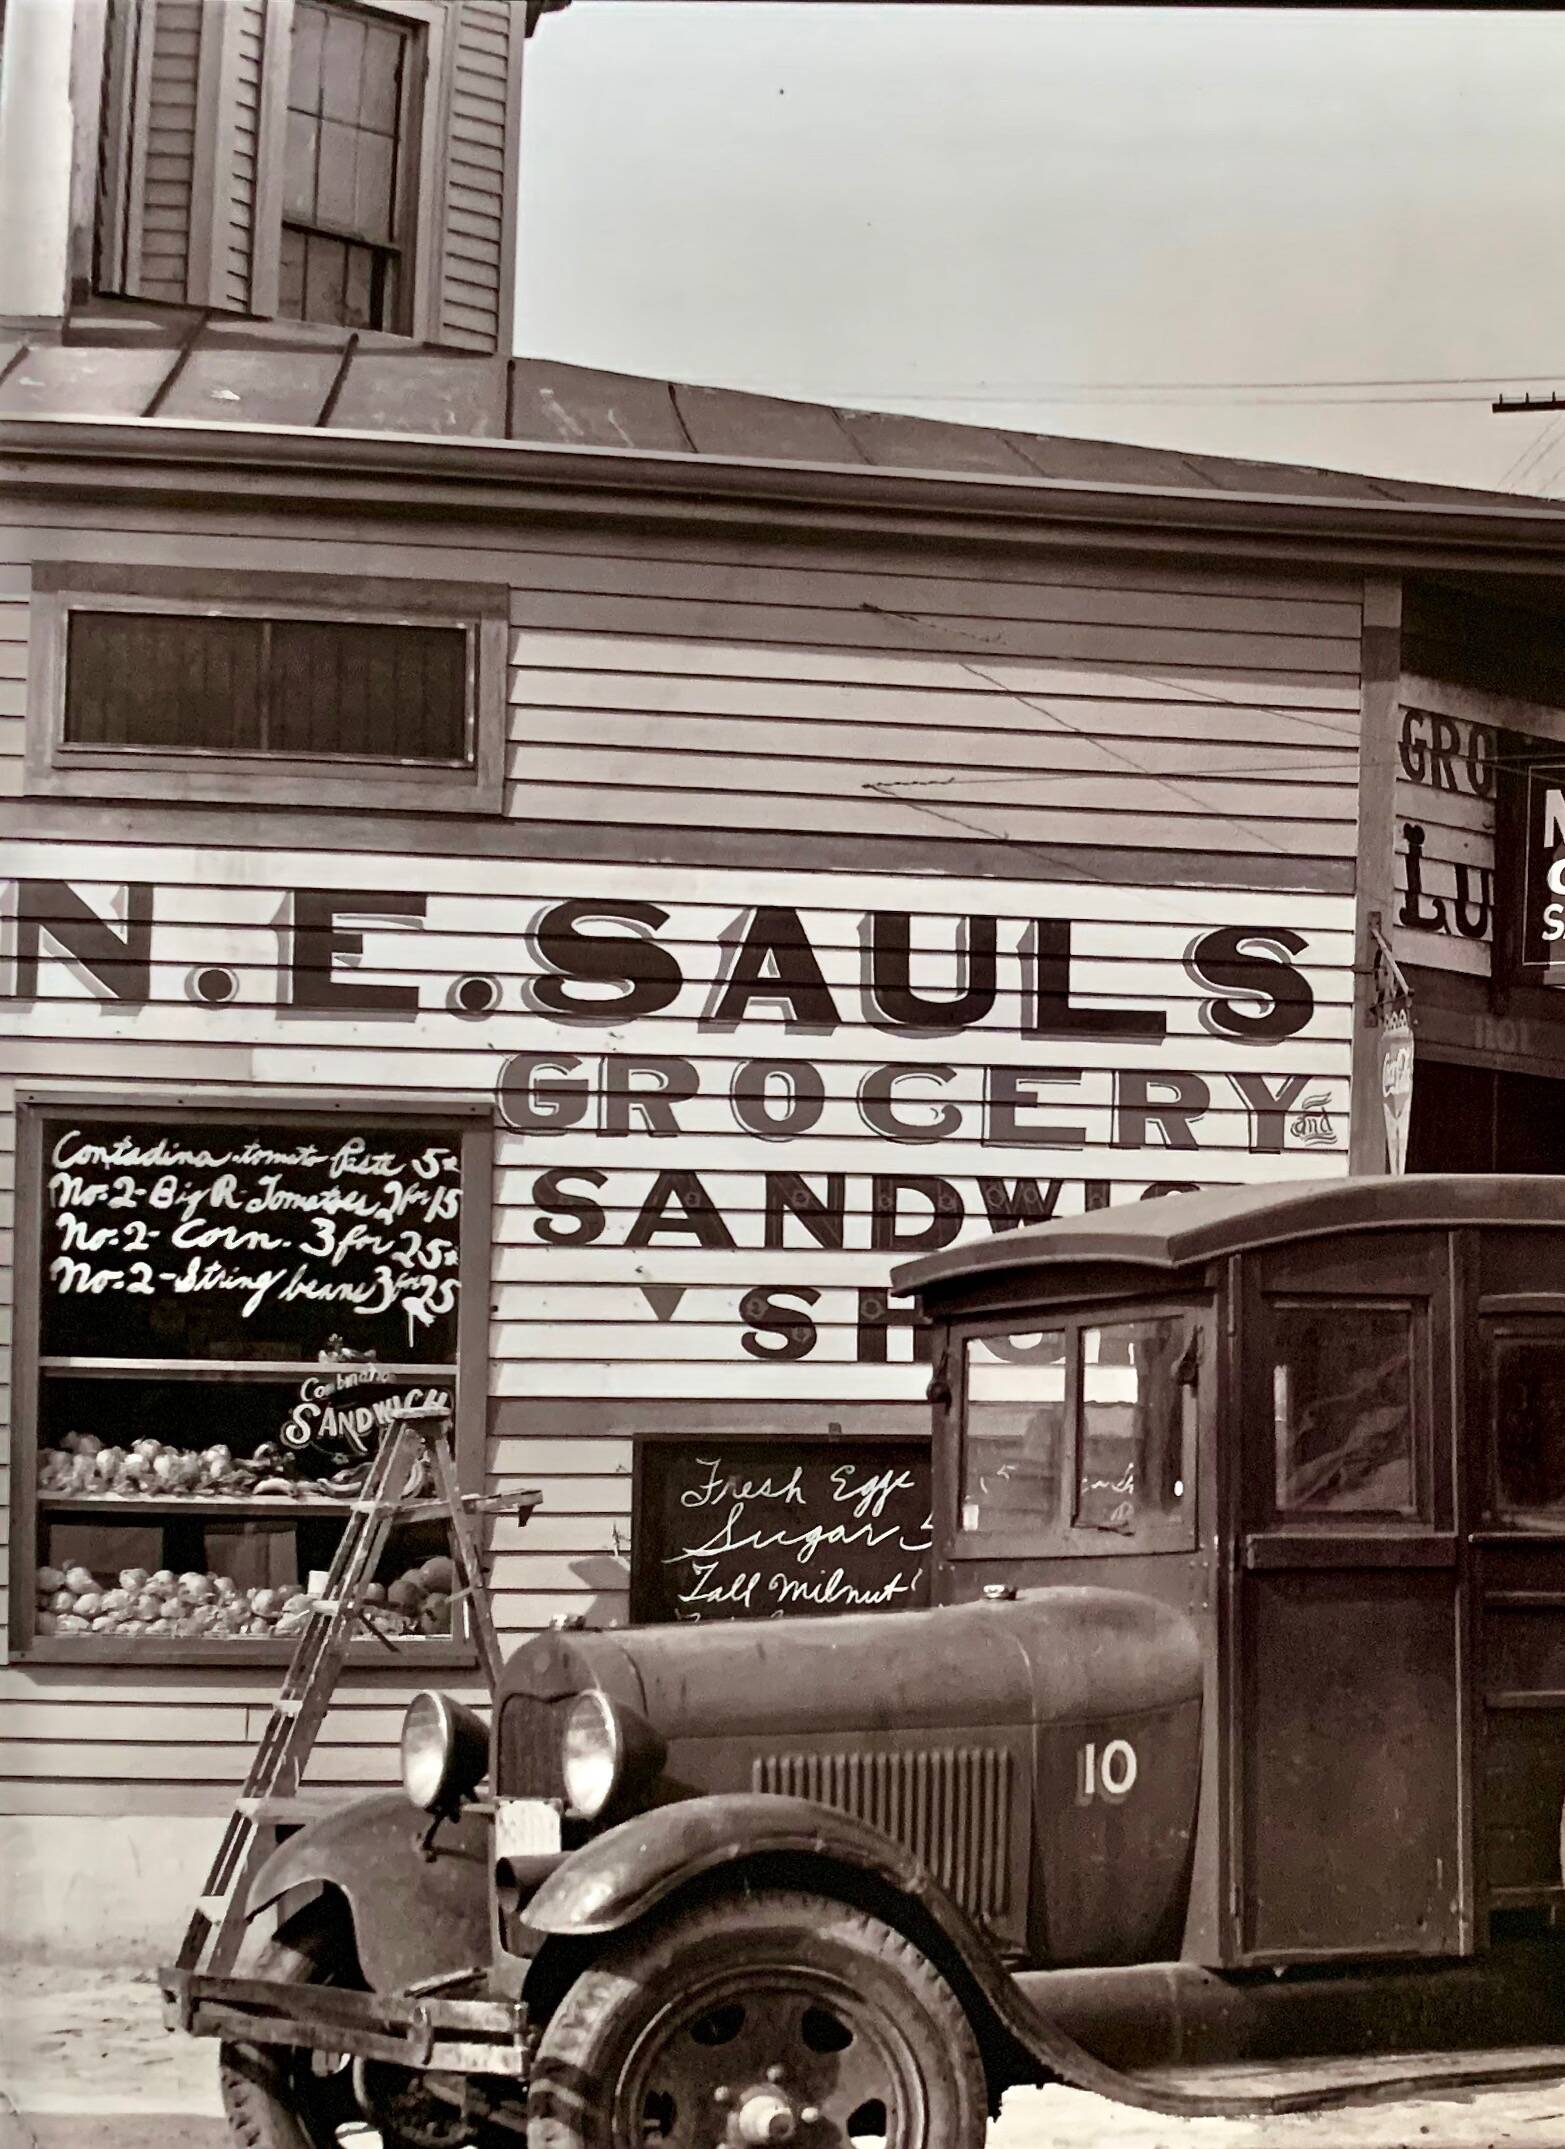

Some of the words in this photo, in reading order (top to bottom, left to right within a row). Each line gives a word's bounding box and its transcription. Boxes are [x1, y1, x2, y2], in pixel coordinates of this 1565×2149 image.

[496, 1053, 1314, 1155] GROCERY
[1290, 1106, 1334, 1138] and
[531, 1167, 1202, 1251] SANDW
[299, 1216, 336, 1257] 3
[331, 1224, 395, 1267] for
[681, 1458, 806, 1507] Fresh
[661, 1502, 900, 1563] Sugar
[677, 1561, 760, 1607] Tall
[1082, 1739, 1137, 1797] 10
